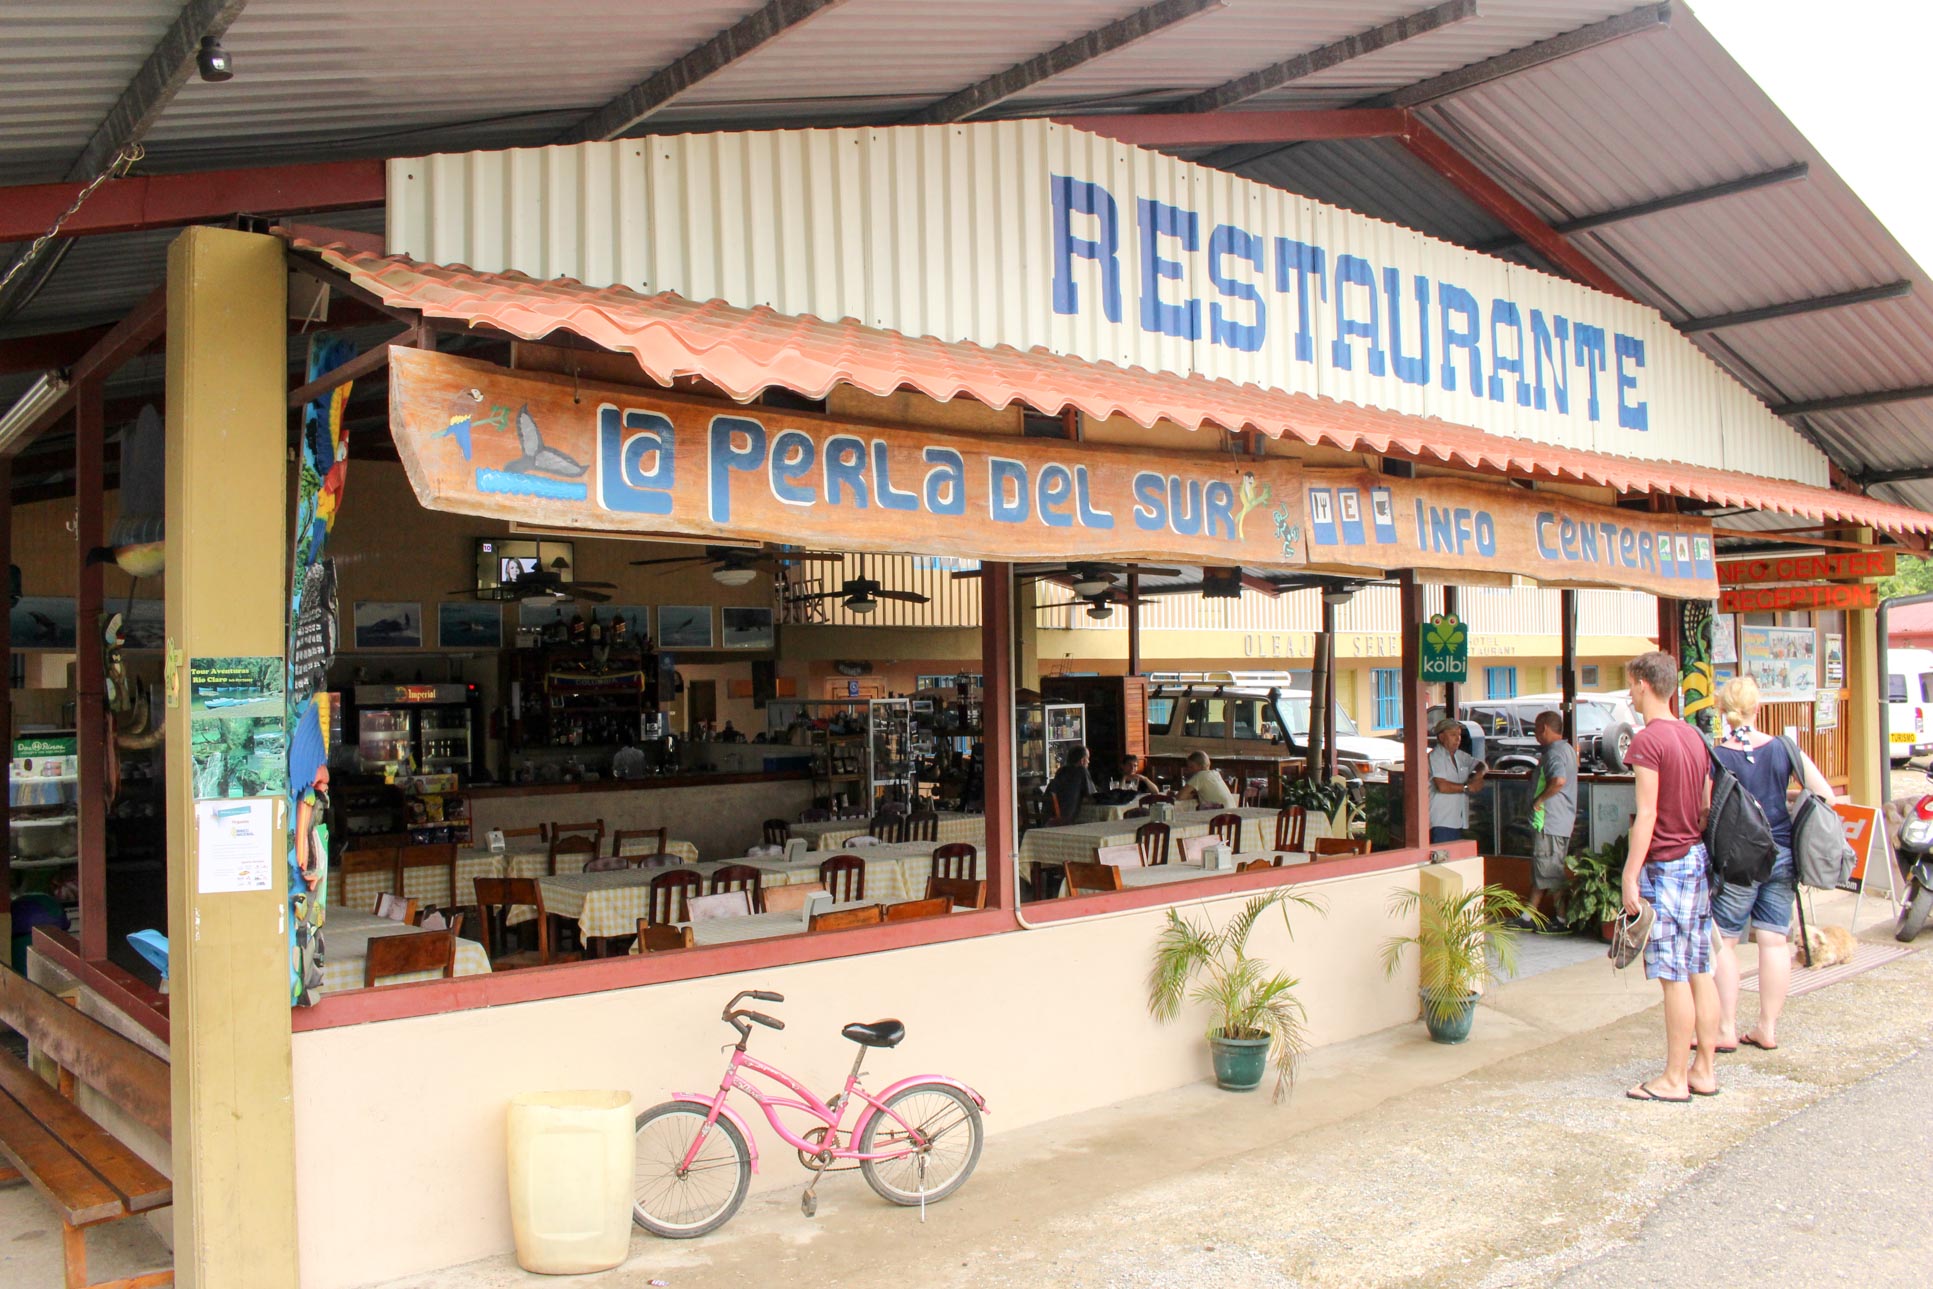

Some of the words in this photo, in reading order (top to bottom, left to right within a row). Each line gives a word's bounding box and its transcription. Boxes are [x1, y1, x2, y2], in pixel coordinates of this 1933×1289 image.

[1050, 172, 1648, 431] RESTAURANTE
[1133, 470, 1236, 537] SUR
[1414, 497, 1497, 558] INFO
[1717, 559, 1768, 583] NFO
[1776, 552, 1886, 580] CENTER
[1722, 585, 1871, 612] RECEPTION
[1244, 634, 1316, 658] OLEAJ
[1423, 655, 1468, 674] kölbi
[408, 688, 437, 702] Imperial
[1890, 732, 1915, 743] TURISMO
